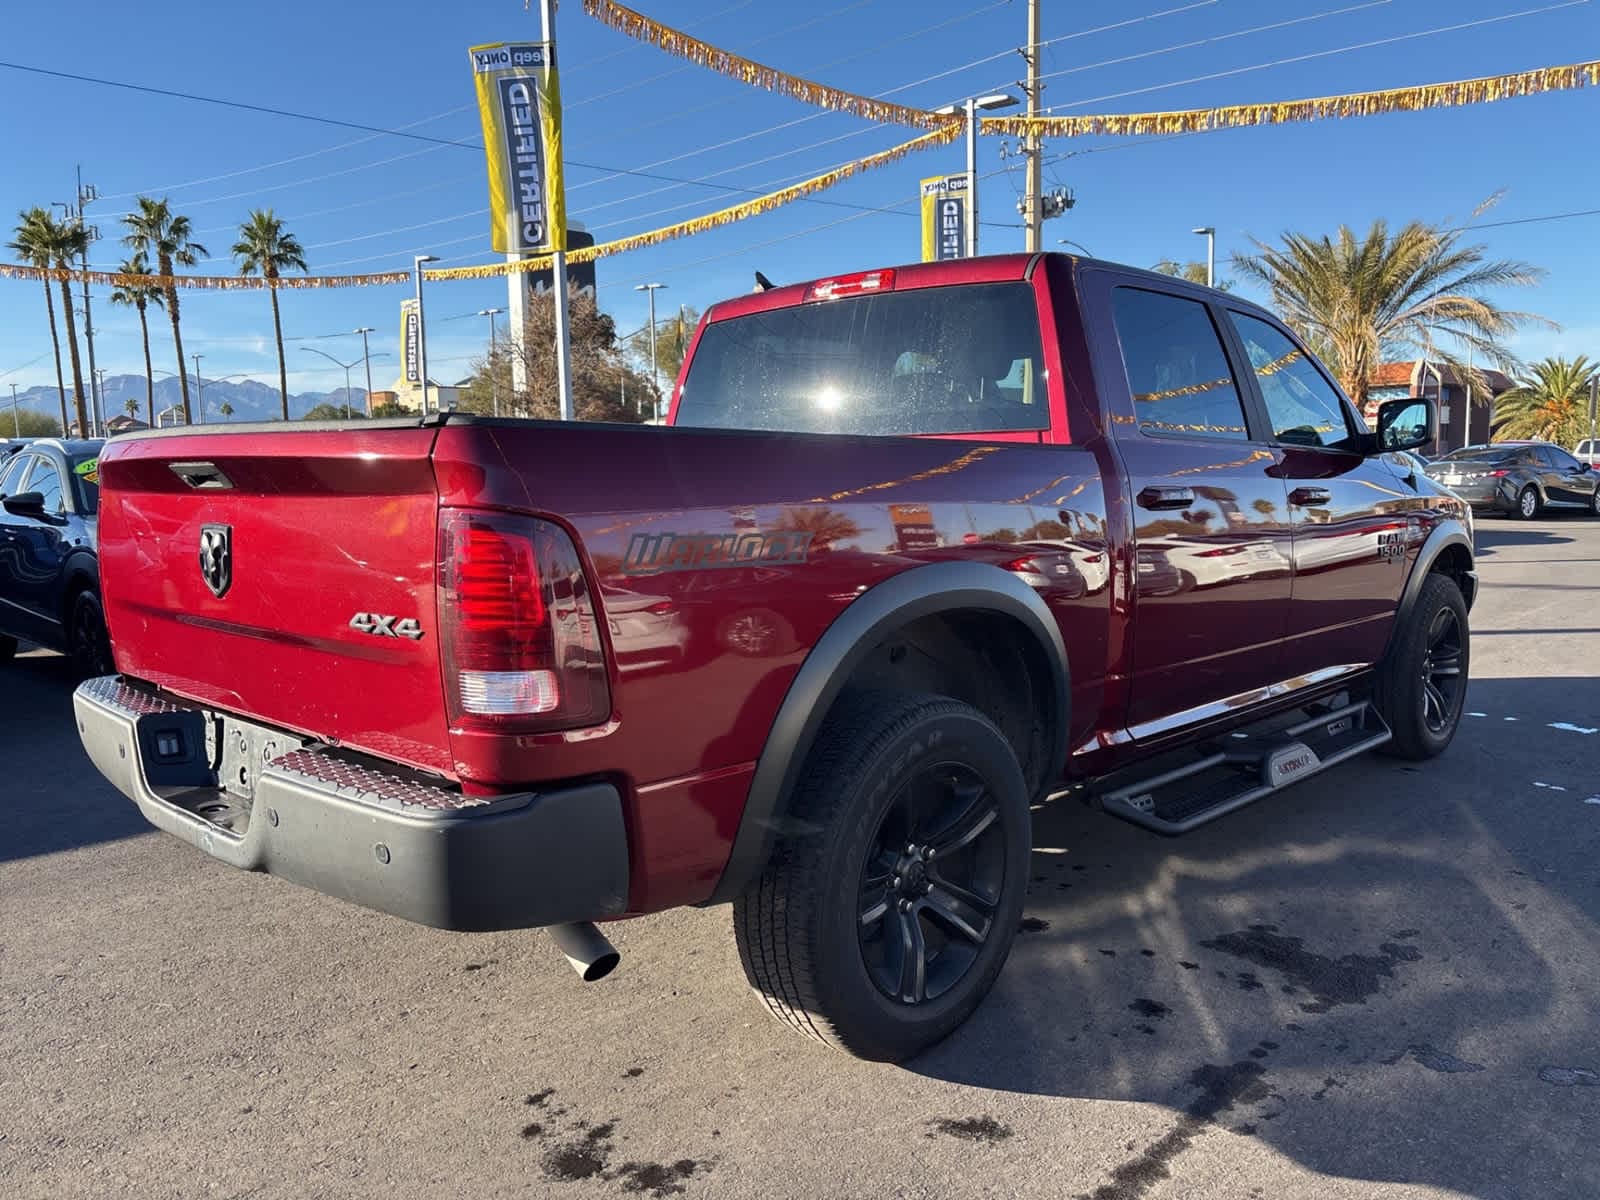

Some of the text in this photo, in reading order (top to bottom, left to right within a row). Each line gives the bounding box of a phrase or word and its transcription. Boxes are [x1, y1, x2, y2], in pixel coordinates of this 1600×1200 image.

[620, 532, 815, 576] WARLOCK
[1378, 545, 1406, 557] 1500
[349, 612, 425, 641] 4X4
